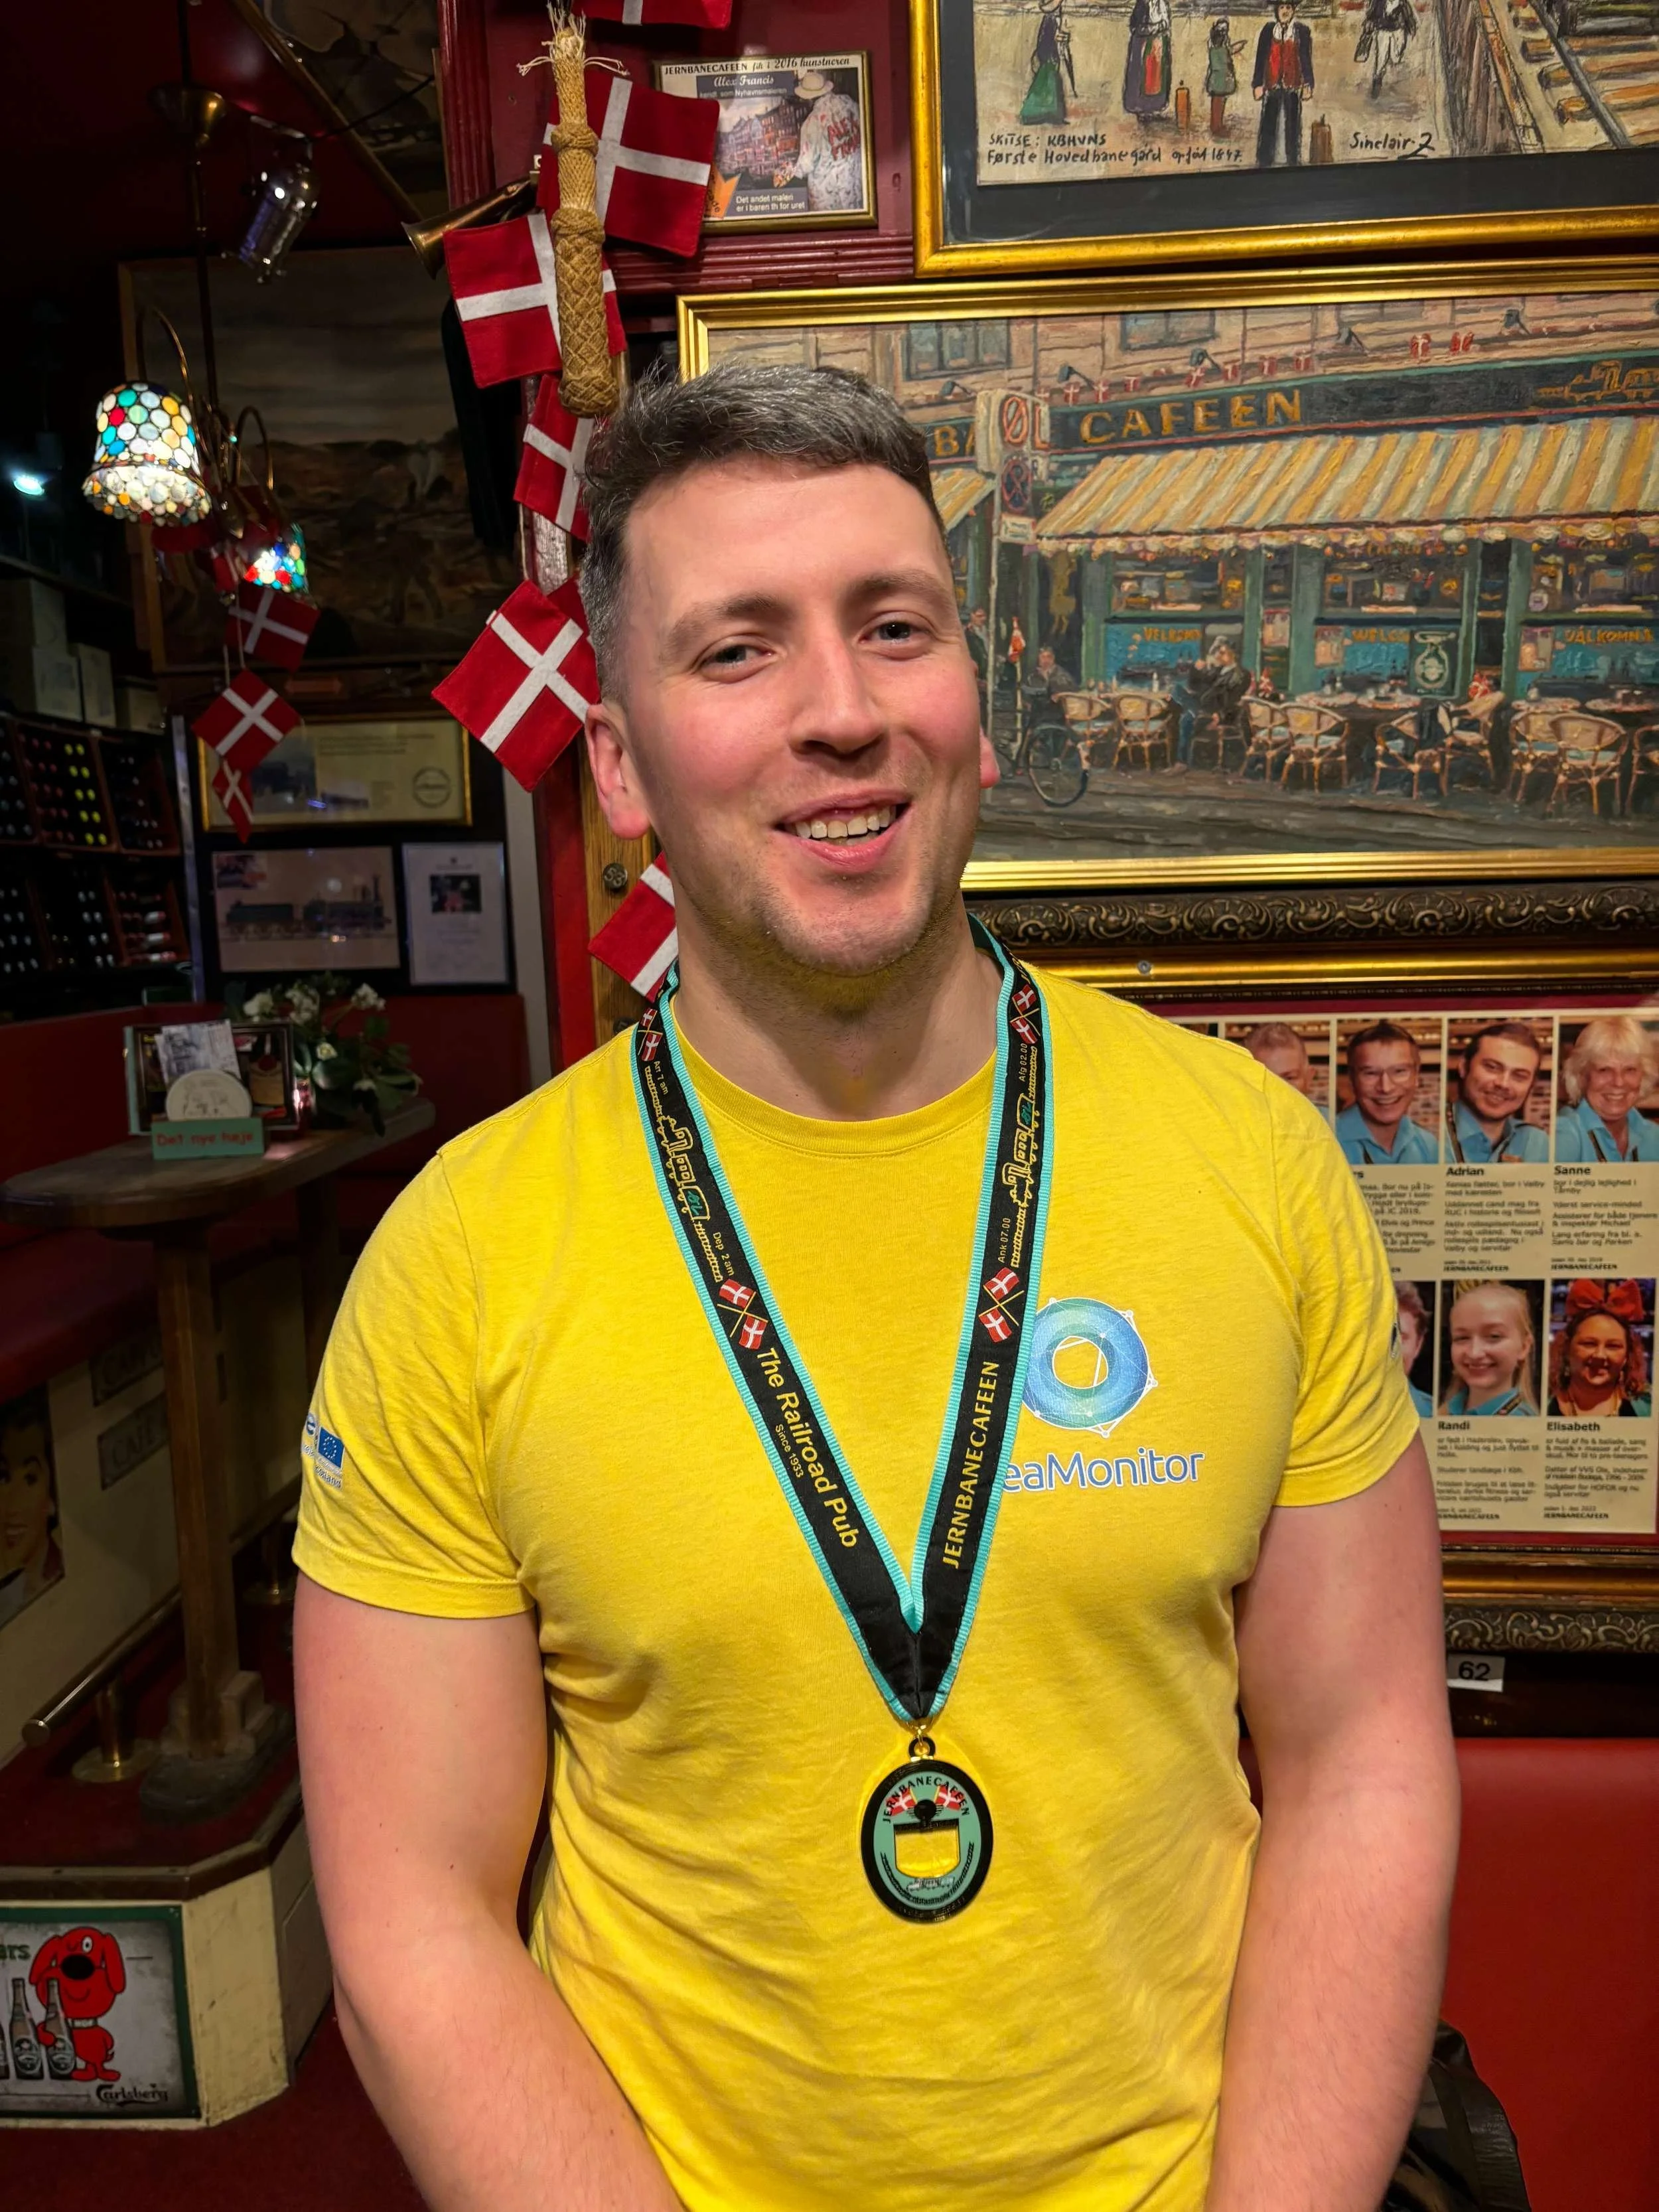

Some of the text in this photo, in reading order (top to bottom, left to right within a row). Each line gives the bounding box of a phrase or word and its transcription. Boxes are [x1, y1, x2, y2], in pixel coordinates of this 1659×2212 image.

[665, 60, 747, 74] JERNBANECAFEEN
[774, 60, 798, 70] 2016
[800, 58, 850, 67] kunstneren
[714, 75, 774, 87] Alex Francis
[987, 149, 1037, 166] Første
[1079, 389, 1302, 443] CAFEEN
[1019, 1043, 1028, 1082] Afg 02.00
[660, 1081, 669, 1095] am
[1446, 1166, 1484, 1176] Adrian
[1554, 1165, 1591, 1175] Sanne
[997, 1218, 1011, 1264] Ank 07.00
[713, 1232, 724, 1250] Dep
[724, 1261, 735, 1276] am
[1438, 1421, 1470, 1430] Randi
[1547, 1422, 1601, 1432] Elisabeth
[757, 1347, 860, 1548] The Railroad Pub
[775, 1424, 804, 1479] Since 1933
[942, 1361, 999, 1570] JERNBANECAFEEN
[1003, 1447, 1206, 1493] eaMonitor
[1459, 1660, 1490, 1681] 62
[882, 1775, 970, 1824] JERNBANECAFEEN
[96, 2083, 169, 2106] Carlsberg
